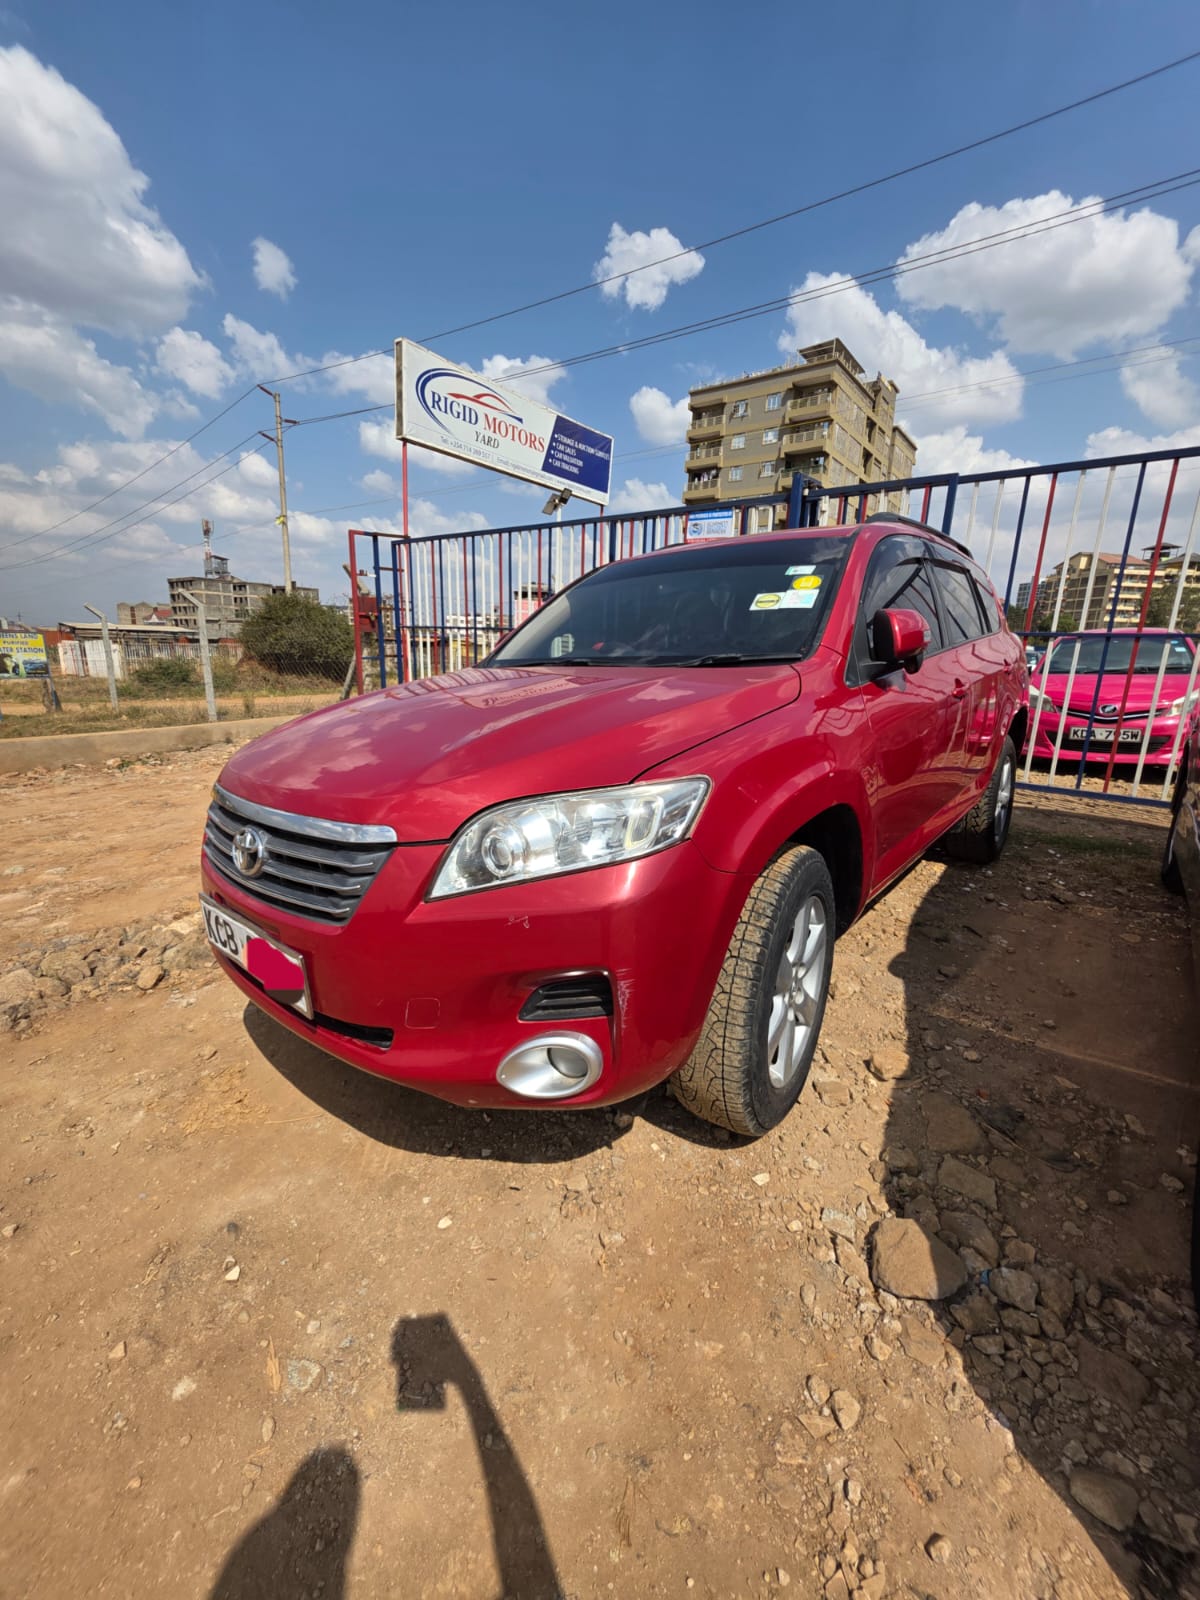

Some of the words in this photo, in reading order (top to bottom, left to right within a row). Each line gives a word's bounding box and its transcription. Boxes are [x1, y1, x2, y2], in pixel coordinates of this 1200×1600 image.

[430, 390, 479, 426] RIGID
[483, 412, 545, 453] MOTORS
[474, 430, 500, 449] YARD
[1072, 728, 1096, 739] KDA
[203, 905, 239, 956] KCB
